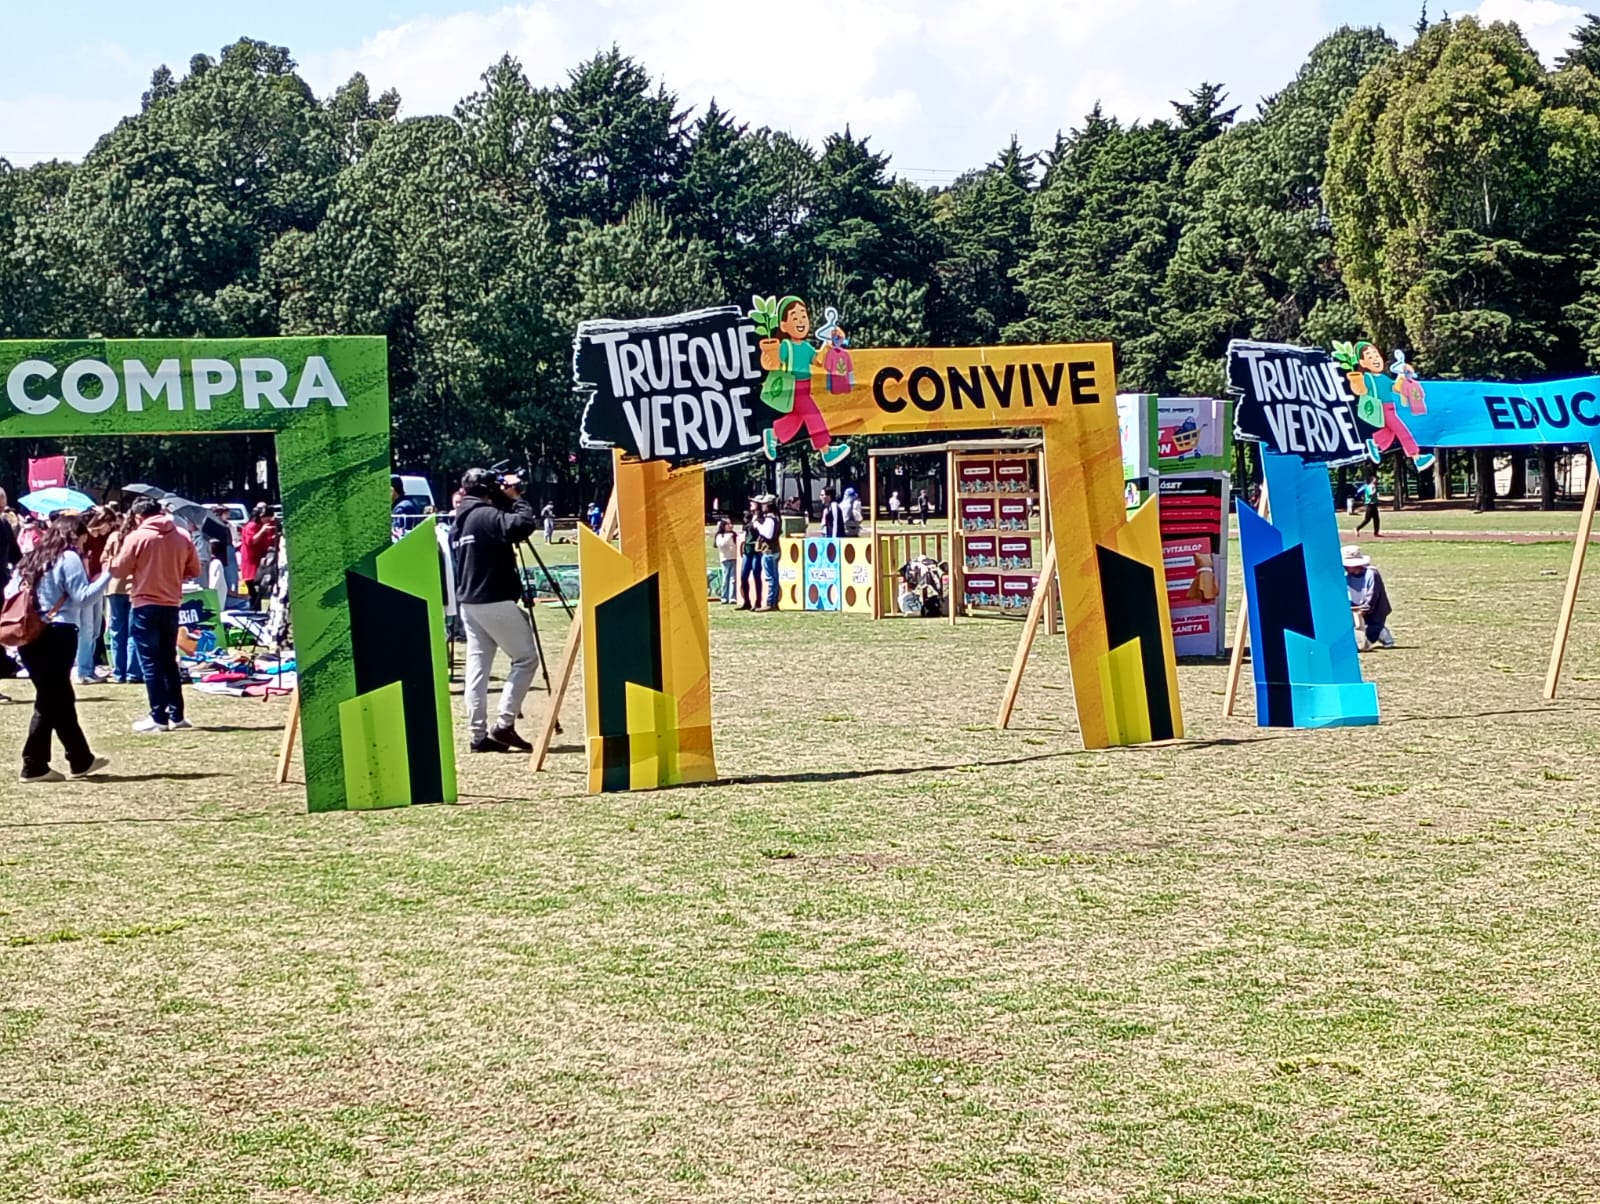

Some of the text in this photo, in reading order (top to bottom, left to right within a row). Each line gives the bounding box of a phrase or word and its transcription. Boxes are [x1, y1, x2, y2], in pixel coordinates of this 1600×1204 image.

[6, 355, 349, 415] COMPRA
[591, 325, 762, 398] TRUEQUE
[872, 360, 1100, 413] CONVIVE
[1238, 350, 1355, 409] TRUEQUE
[622, 386, 761, 460] VERDE
[1263, 403, 1366, 454] VERDE
[1483, 391, 1600, 430] EDUC
